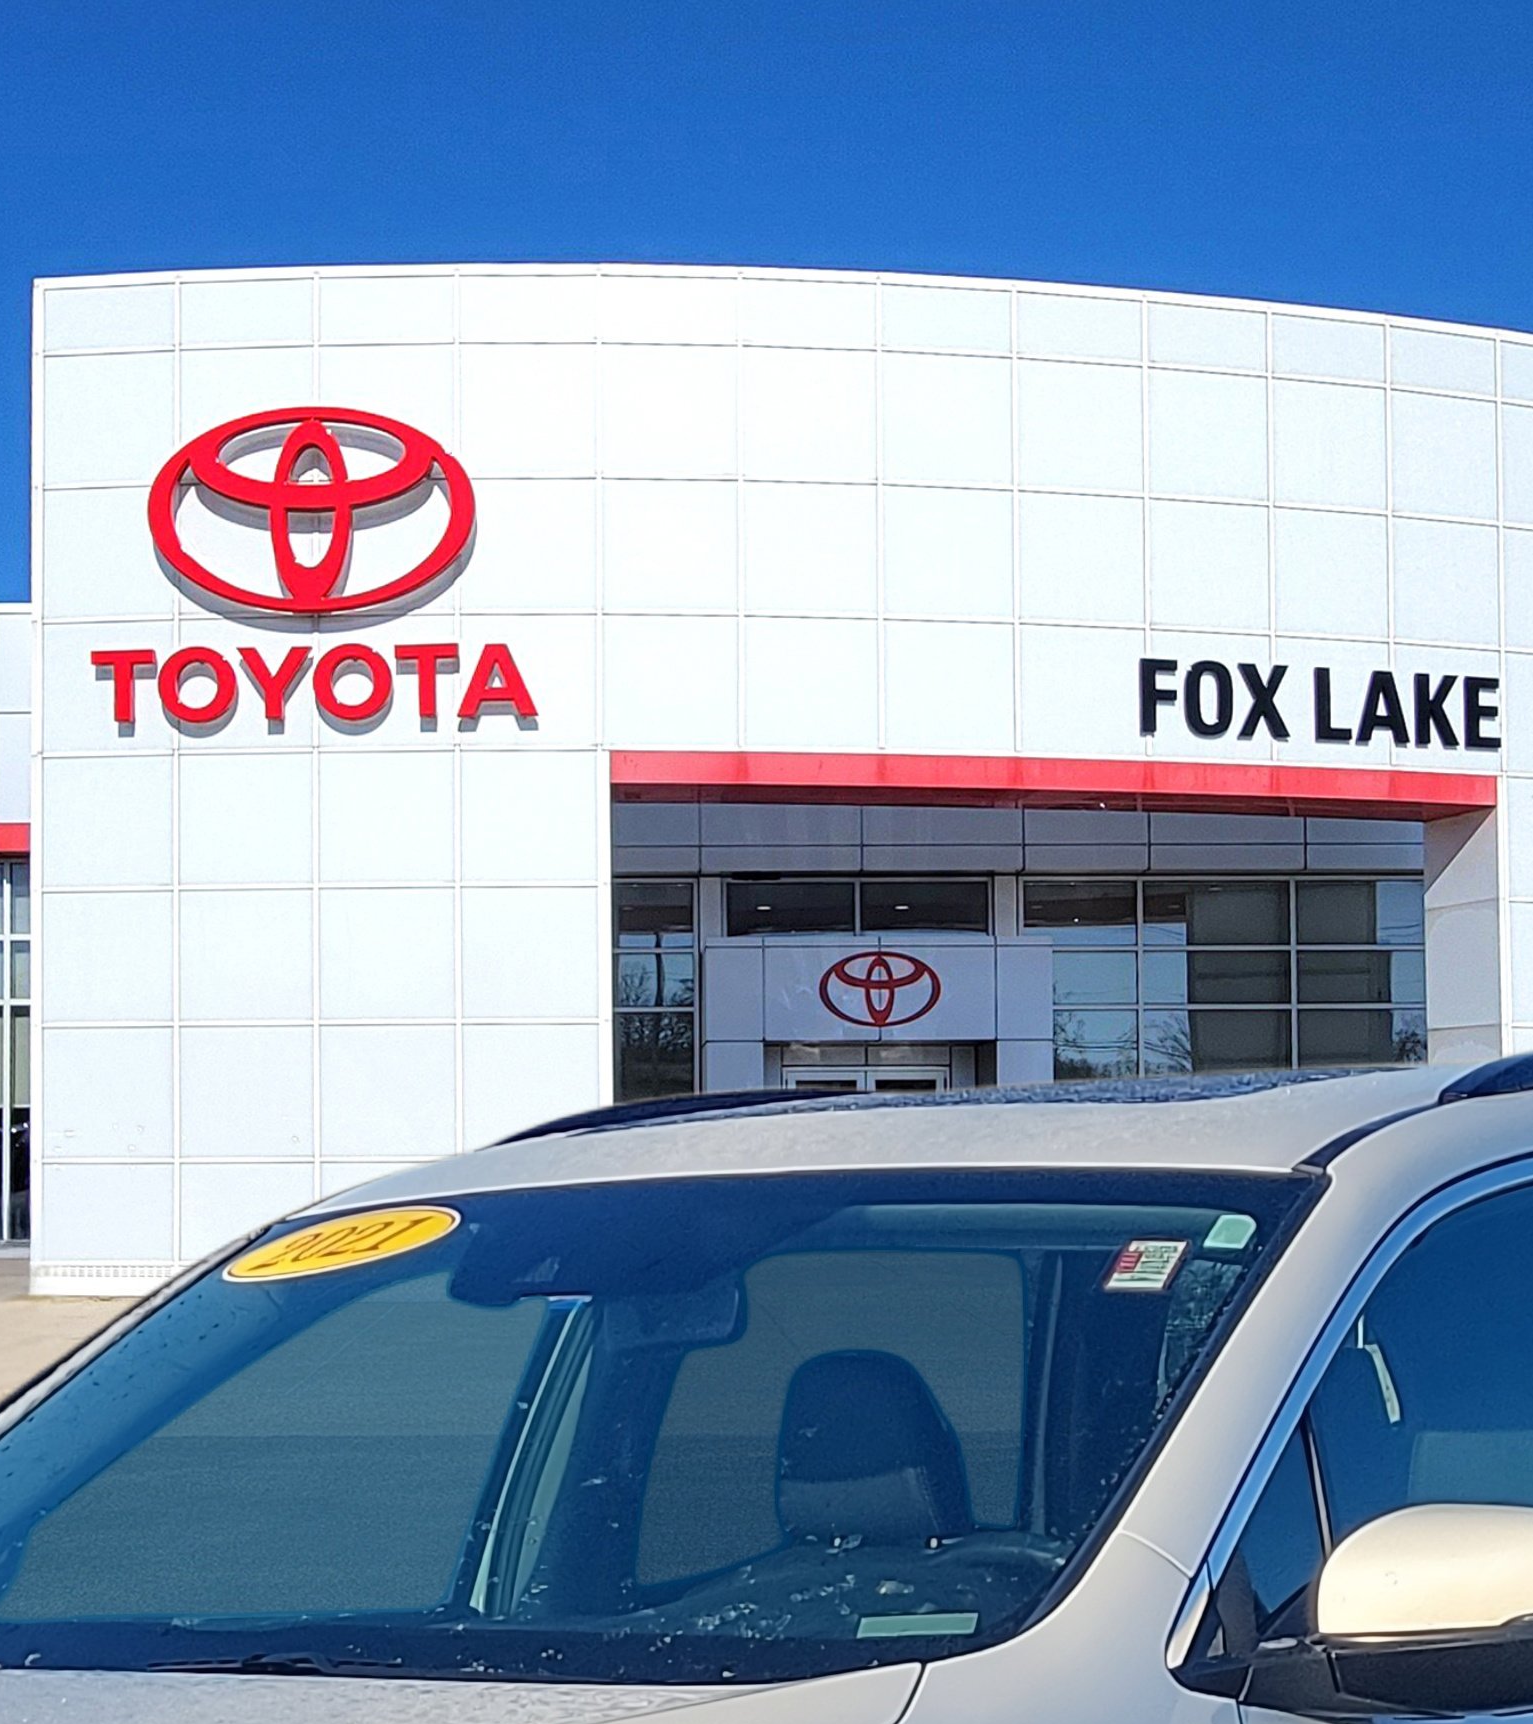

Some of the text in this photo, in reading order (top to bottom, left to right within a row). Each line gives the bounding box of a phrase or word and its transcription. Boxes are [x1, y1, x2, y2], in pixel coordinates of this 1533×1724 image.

[91, 643, 539, 724] TOYOTA
[1139, 658, 1502, 749] FOX LAKE
[246, 1216, 434, 1271] 2021
